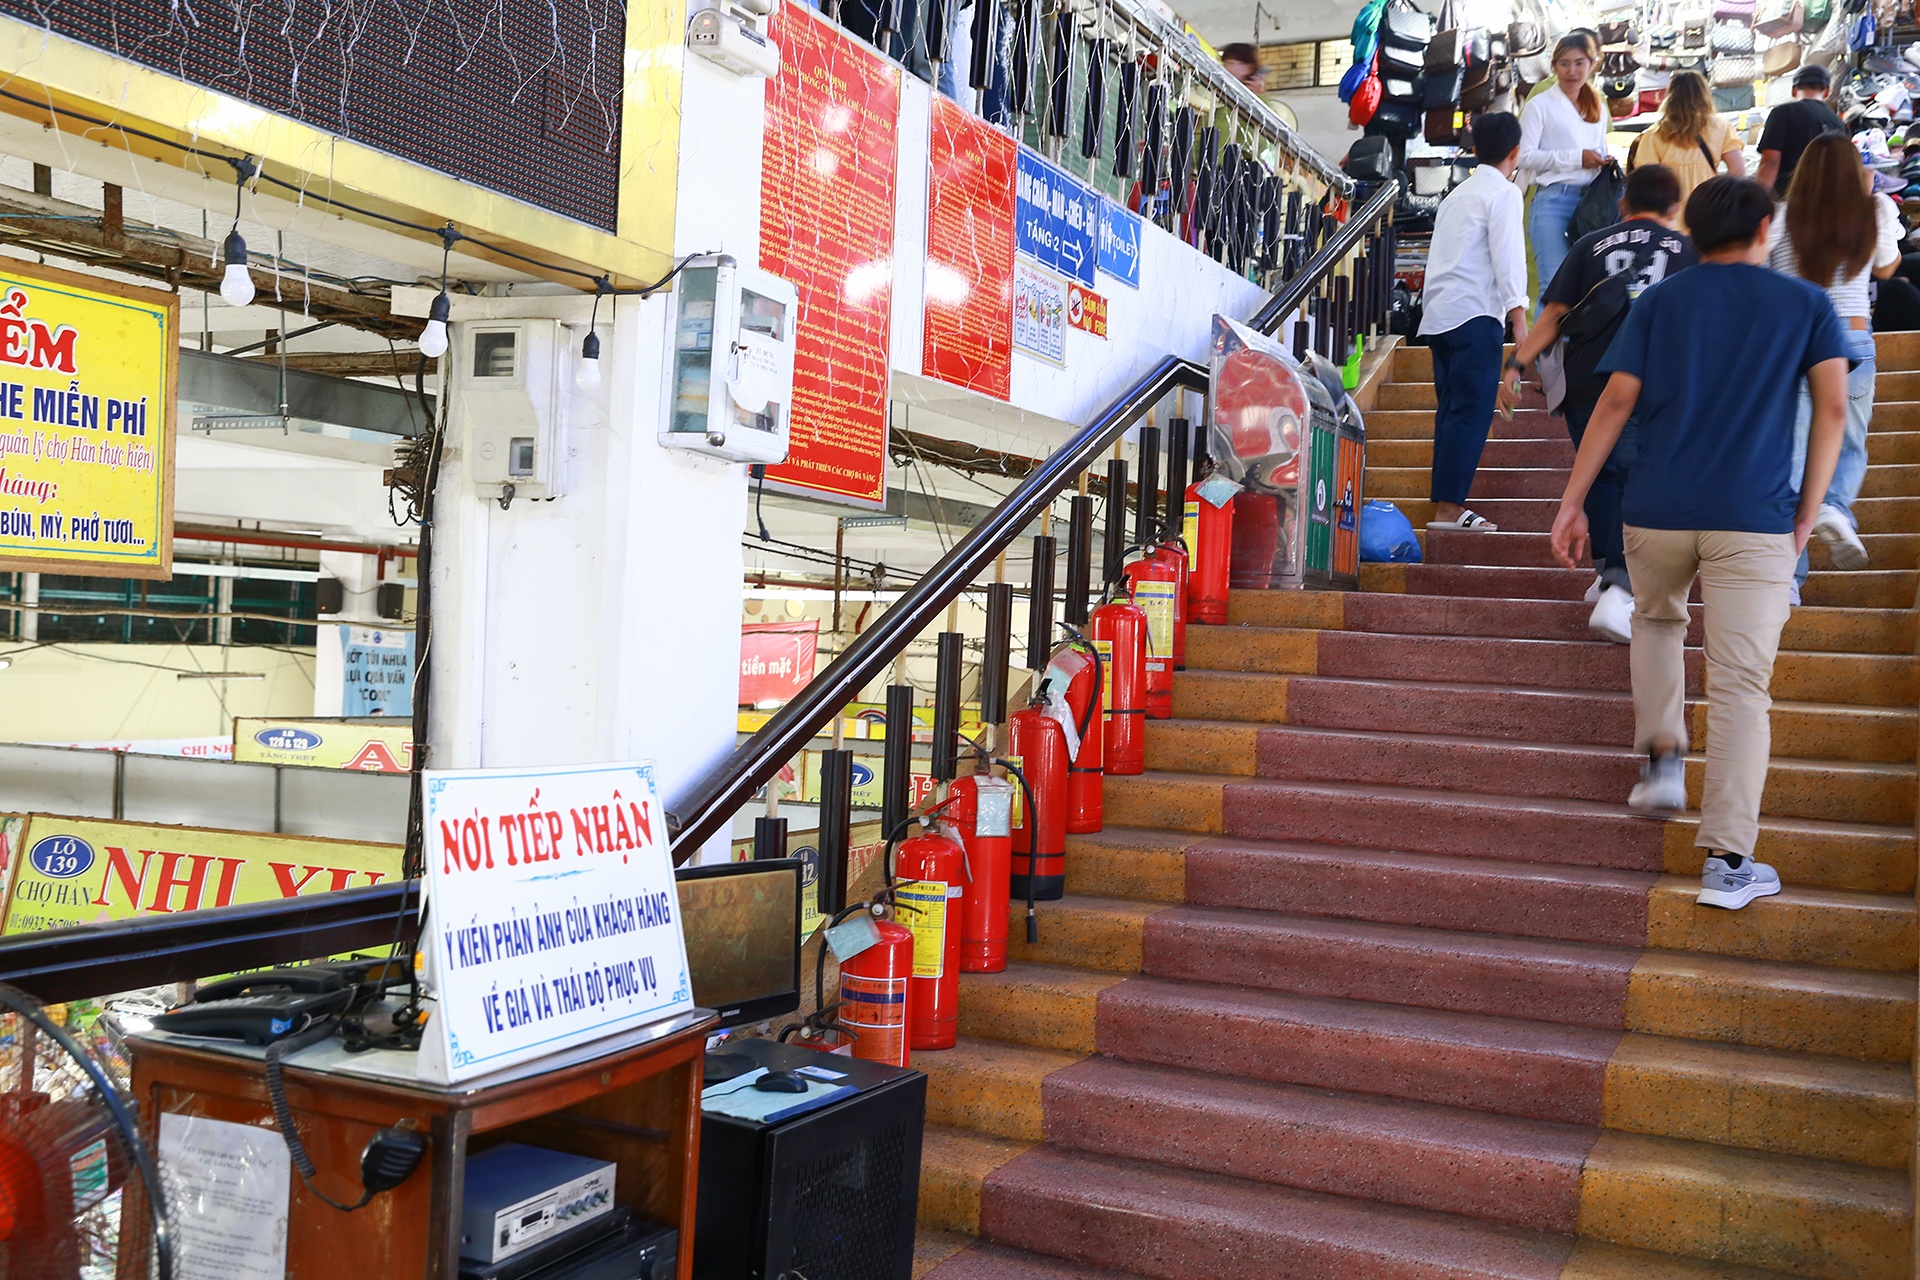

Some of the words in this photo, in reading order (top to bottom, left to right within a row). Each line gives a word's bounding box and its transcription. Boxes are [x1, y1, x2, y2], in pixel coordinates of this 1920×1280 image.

[1053, 236, 1060, 252] 2
[1111, 235, 1135, 258] TOILET
[34, 381, 98, 431] MIỄN
[108, 397, 147, 437] PHÍ
[0, 428, 29, 458] quản
[33, 431, 45, 462] lý
[46, 433, 70, 460] chợ
[71, 440, 97, 465] Hàn
[99, 445, 126, 475] thực
[127, 444, 155, 476] hiện)
[1, 511, 36, 541] BÚN,
[41, 511, 67, 543] MỲ,
[71, 513, 100, 543] PHỞ
[742, 655, 766, 676] tiền
[768, 657, 792, 679] mặt
[181, 745, 207, 756] CHỊ
[440, 807, 495, 875] NƠI
[499, 787, 563, 867] TIẾP
[570, 789, 652, 865] NHẬN
[52, 838, 77, 856] LÔ
[44, 855, 78, 874] 139
[92, 846, 249, 913] NHI
[16, 880, 55, 908] CHỢ
[445, 923, 454, 970] Ý
[457, 913, 492, 968] KIẾN
[493, 907, 534, 960] PHẢN
[535, 903, 565, 952] ẢNH
[565, 896, 594, 944] CỦA
[592, 894, 636, 938] KHÁCH
[635, 888, 672, 930] HÀNG
[482, 980, 504, 1034] VỀ
[504, 980, 532, 1030] GIÁ
[531, 974, 554, 1021] VÀ
[552, 967, 586, 1016] THÁI
[584, 962, 606, 1012] ĐỘ
[604, 960, 639, 1005] PHỤC
[637, 956, 657, 997] VỤ
